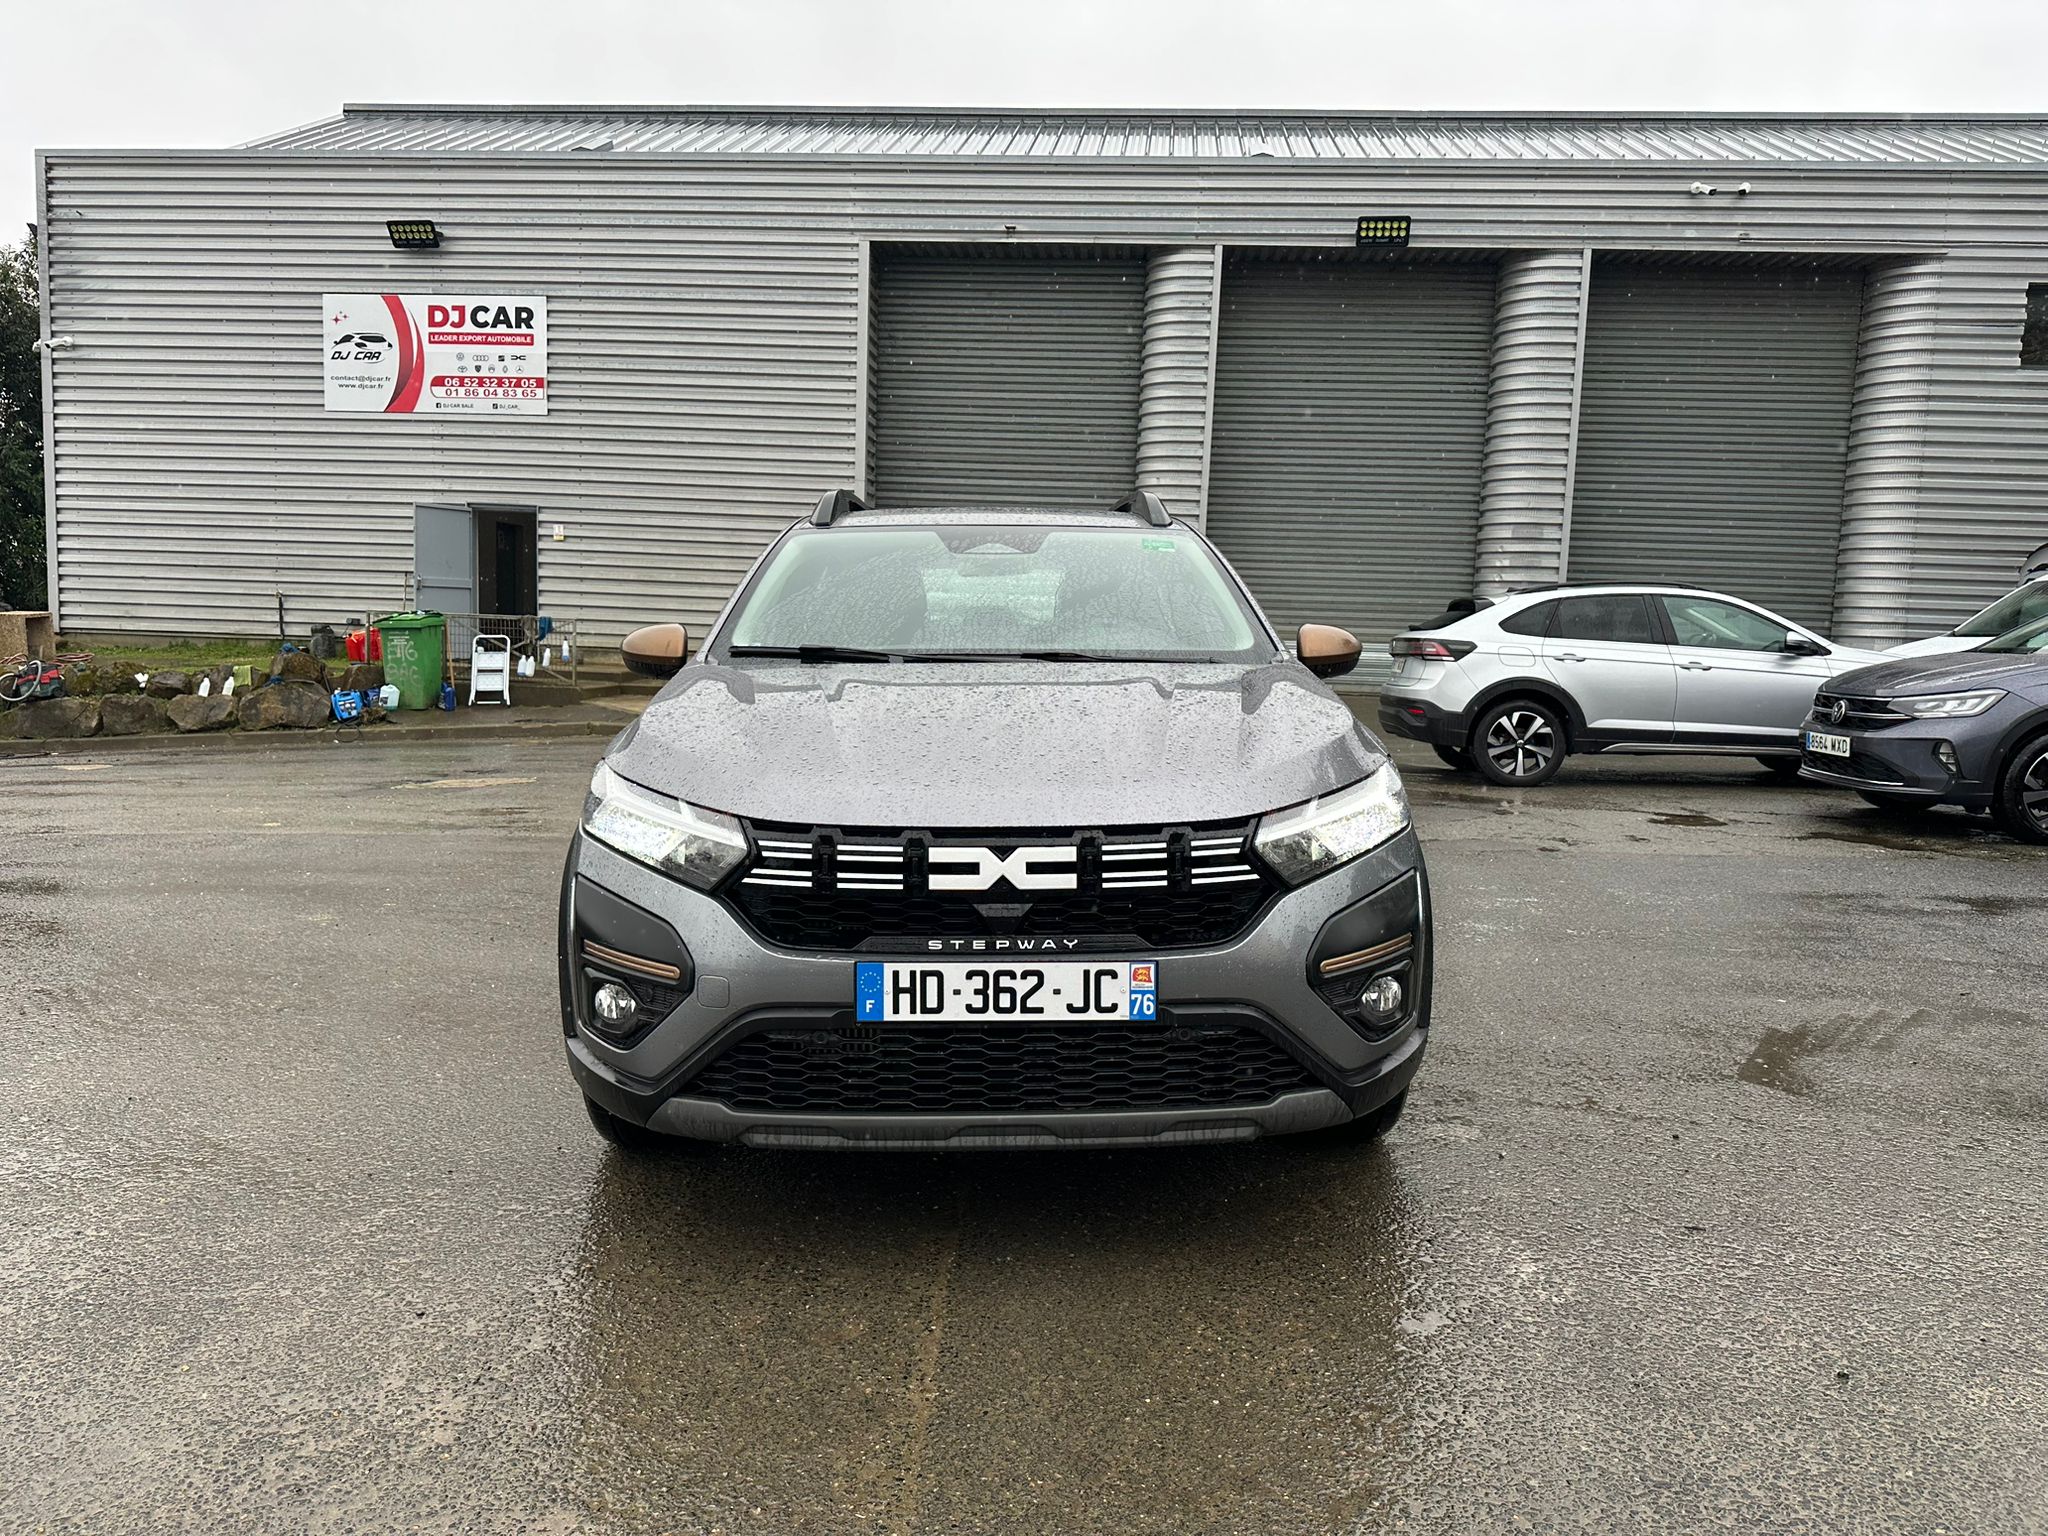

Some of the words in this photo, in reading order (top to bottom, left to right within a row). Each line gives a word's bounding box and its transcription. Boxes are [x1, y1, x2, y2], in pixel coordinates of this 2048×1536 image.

[428, 305, 466, 328] DJ
[470, 305, 534, 329] CAR
[430, 334, 458, 342] LEADER
[459, 335, 486, 343] EXPORT
[331, 351, 351, 360] DJ
[444, 378, 460, 386] 06
[463, 378, 479, 387] 52
[482, 378, 498, 387] 32
[501, 379, 518, 387] 37
[520, 379, 537, 388] 05
[445, 388, 459, 396] 01
[464, 389, 479, 397] 86
[483, 389, 498, 397] 04
[502, 389, 518, 397] 83
[521, 389, 537, 397] 65
[928, 939, 1078, 950] STEPWAY
[865, 1000, 875, 1013] F
[892, 969, 1118, 1014] HD-362-JC
[1131, 993, 1154, 1015] 76
